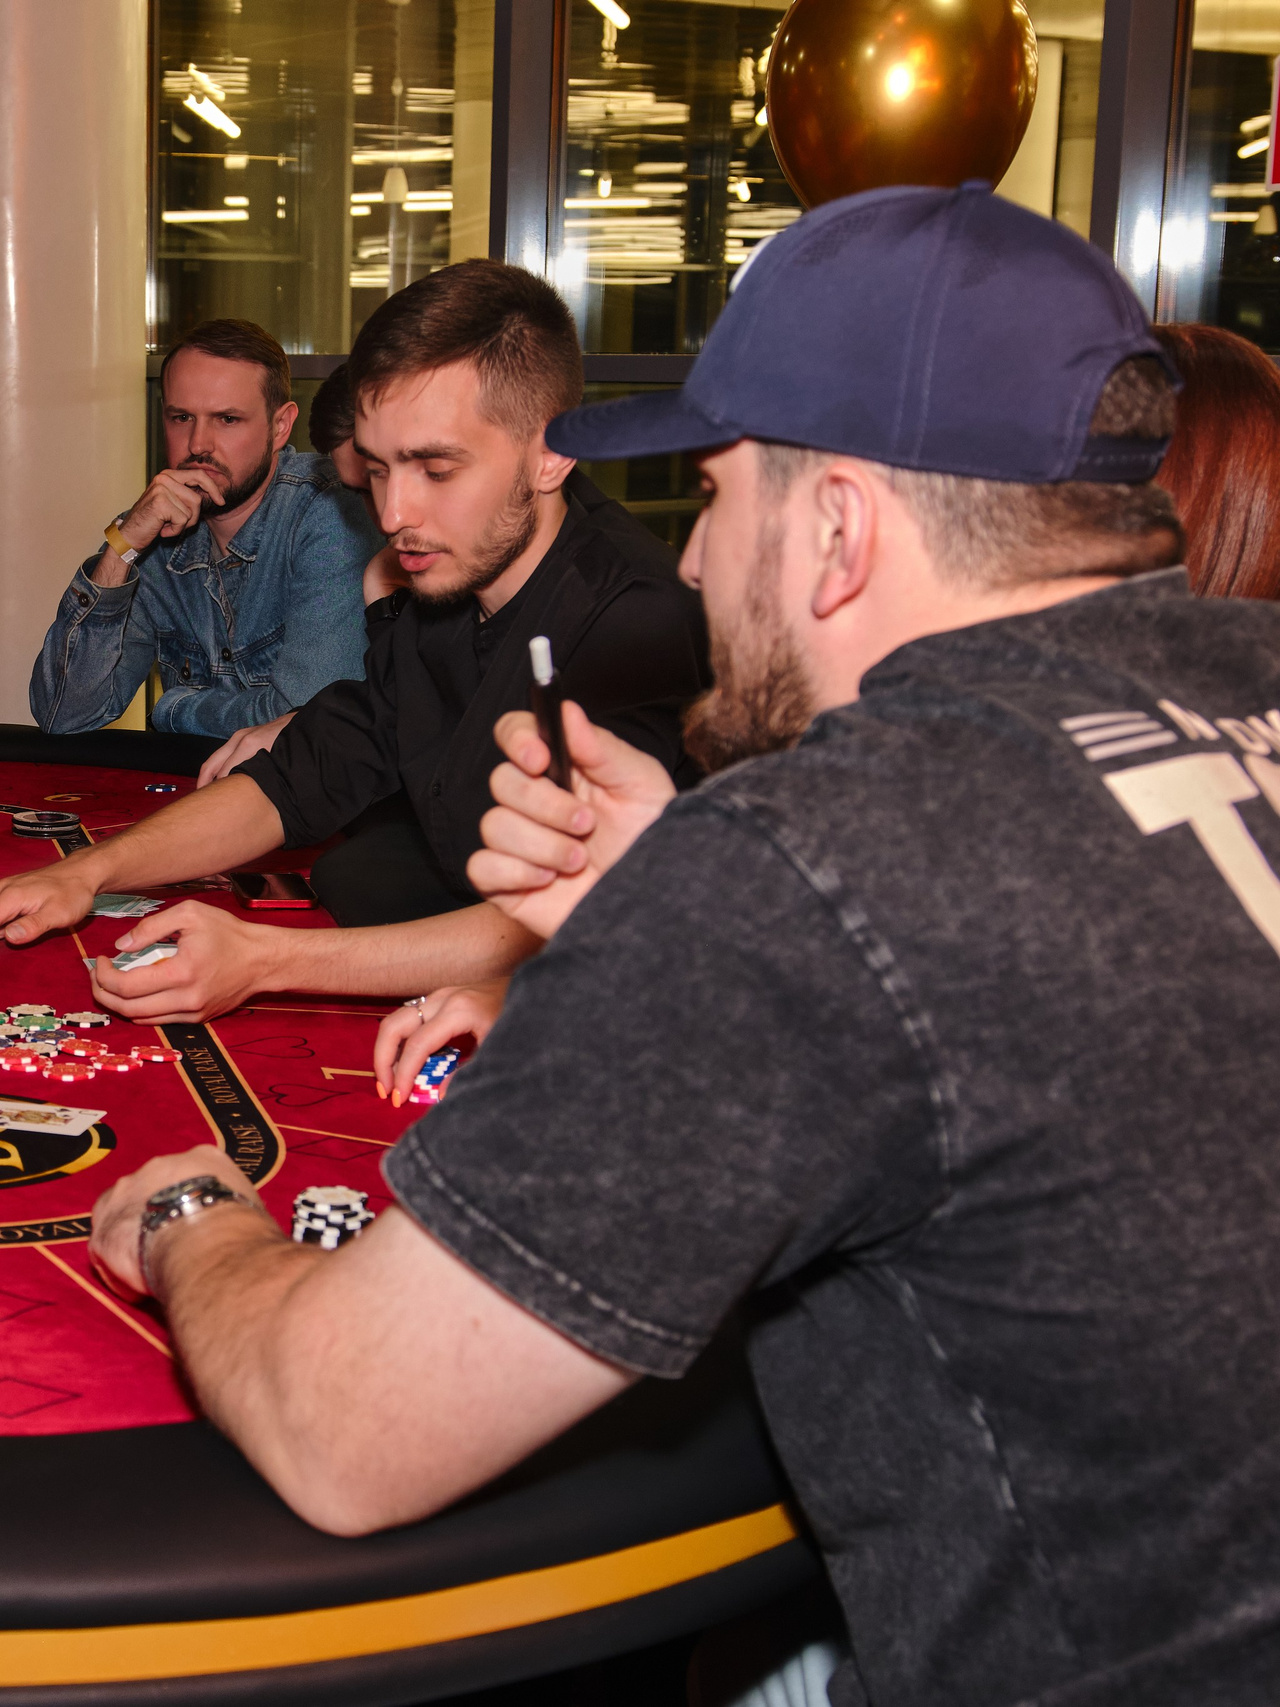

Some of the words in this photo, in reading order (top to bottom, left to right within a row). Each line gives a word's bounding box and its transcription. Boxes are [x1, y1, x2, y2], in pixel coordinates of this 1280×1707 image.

[184, 1046, 220, 1073] RAISE
[200, 1072, 240, 1104] ROYAL
[228, 1123, 266, 1159] RAISE
